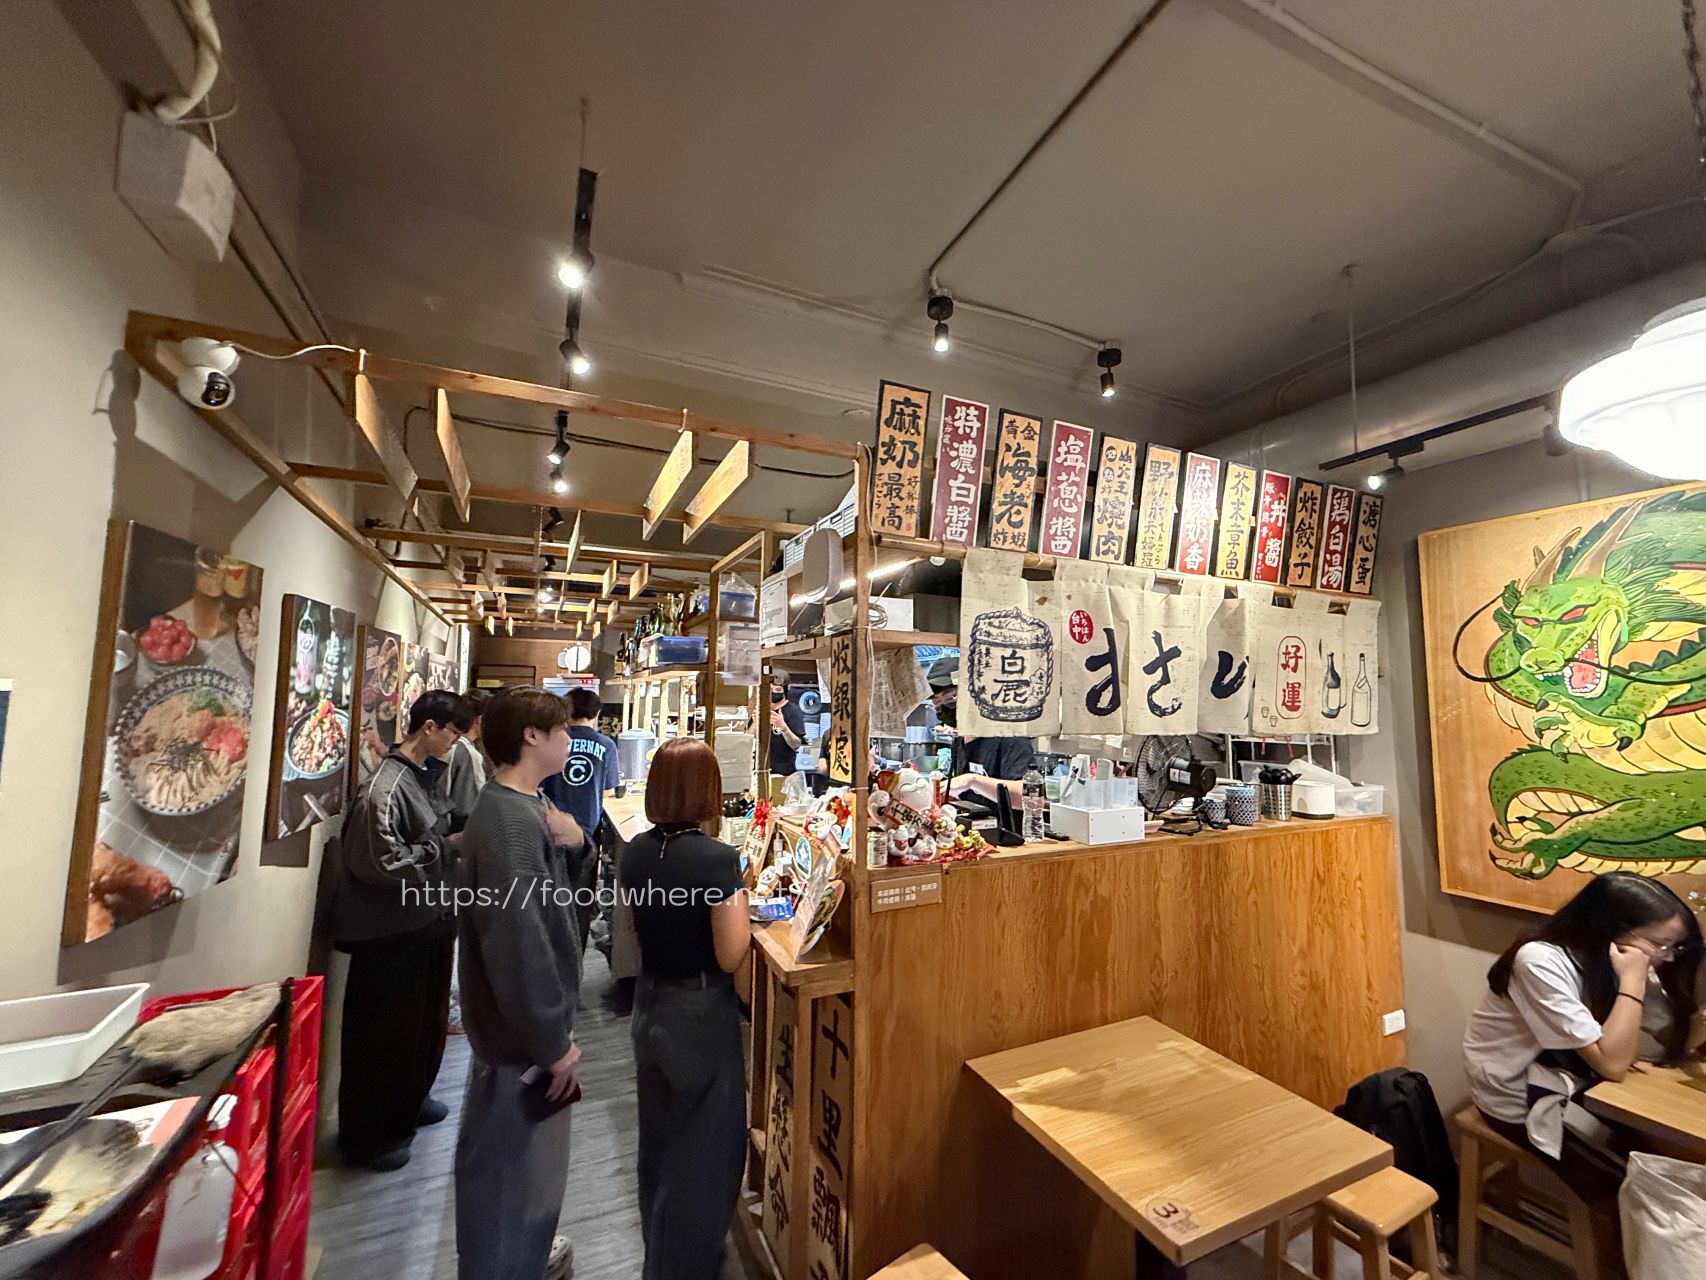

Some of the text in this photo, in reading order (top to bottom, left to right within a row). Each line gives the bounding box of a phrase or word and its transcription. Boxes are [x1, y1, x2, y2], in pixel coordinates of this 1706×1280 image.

[994, 442, 1038, 530] 海老
[1220, 470, 1251, 578] 芥末章魚
[1293, 490, 1318, 580] 炸餃子
[1071, 613, 1082, 641] 台中
[831, 638, 851, 777] 收銀處
[1281, 645, 1303, 712] 好運
[1152, 1202, 1180, 1219] 3
